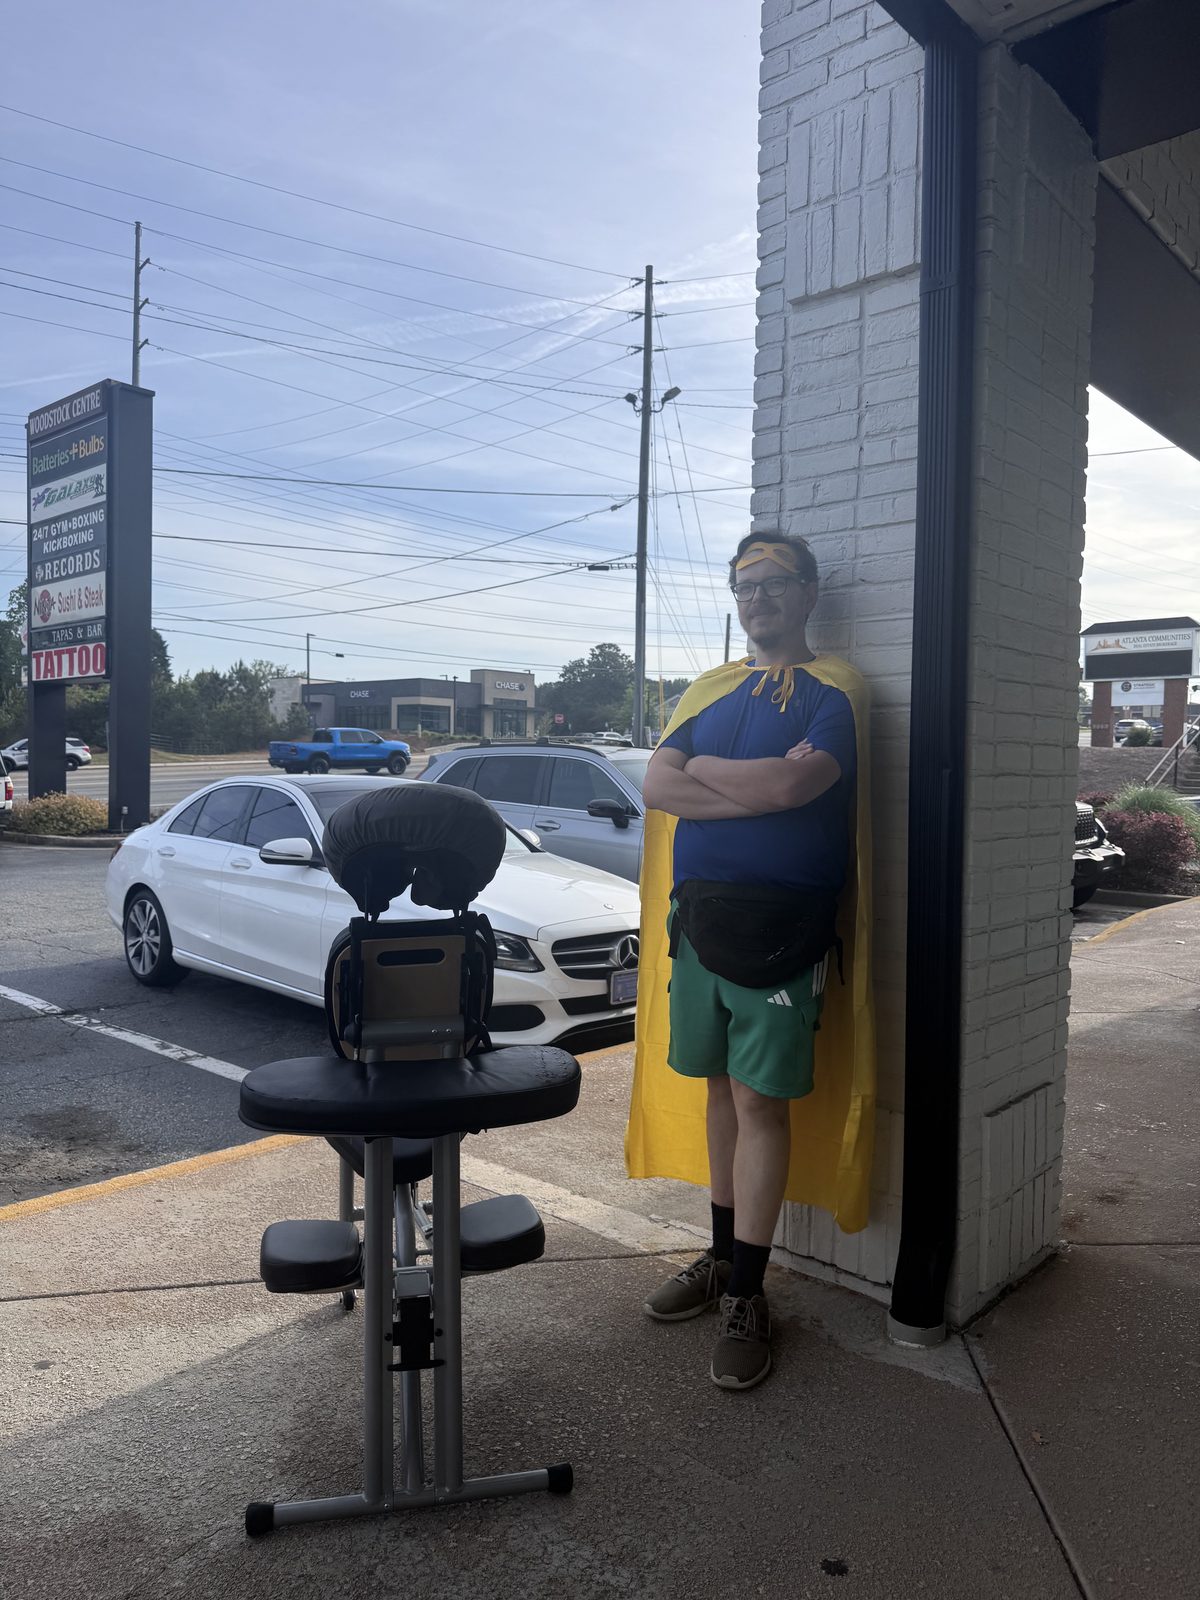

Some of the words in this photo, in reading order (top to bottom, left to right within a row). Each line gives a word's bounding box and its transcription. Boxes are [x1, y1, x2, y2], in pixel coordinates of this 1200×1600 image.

[30, 403, 71, 435] WOODSTOCK
[72, 389, 101, 417] CENTRE
[32, 525, 49, 542] 24/7
[42, 529, 94, 554] KICKBOXING
[44, 548, 101, 581] RECORDS
[57, 590, 77, 613] Sushi
[77, 588, 83, 609] &
[84, 583, 104, 609] Steak
[52, 628, 74, 642] TAPAS
[76, 626, 84, 639] &
[87, 623, 103, 638] BAR
[1121, 636, 1147, 644] ATLANTA
[1147, 633, 1191, 643] COMMUNITIES
[32, 643, 106, 680] TATTOO
[349, 690, 370, 699] CHASE
[495, 680, 520, 691] CHASE
